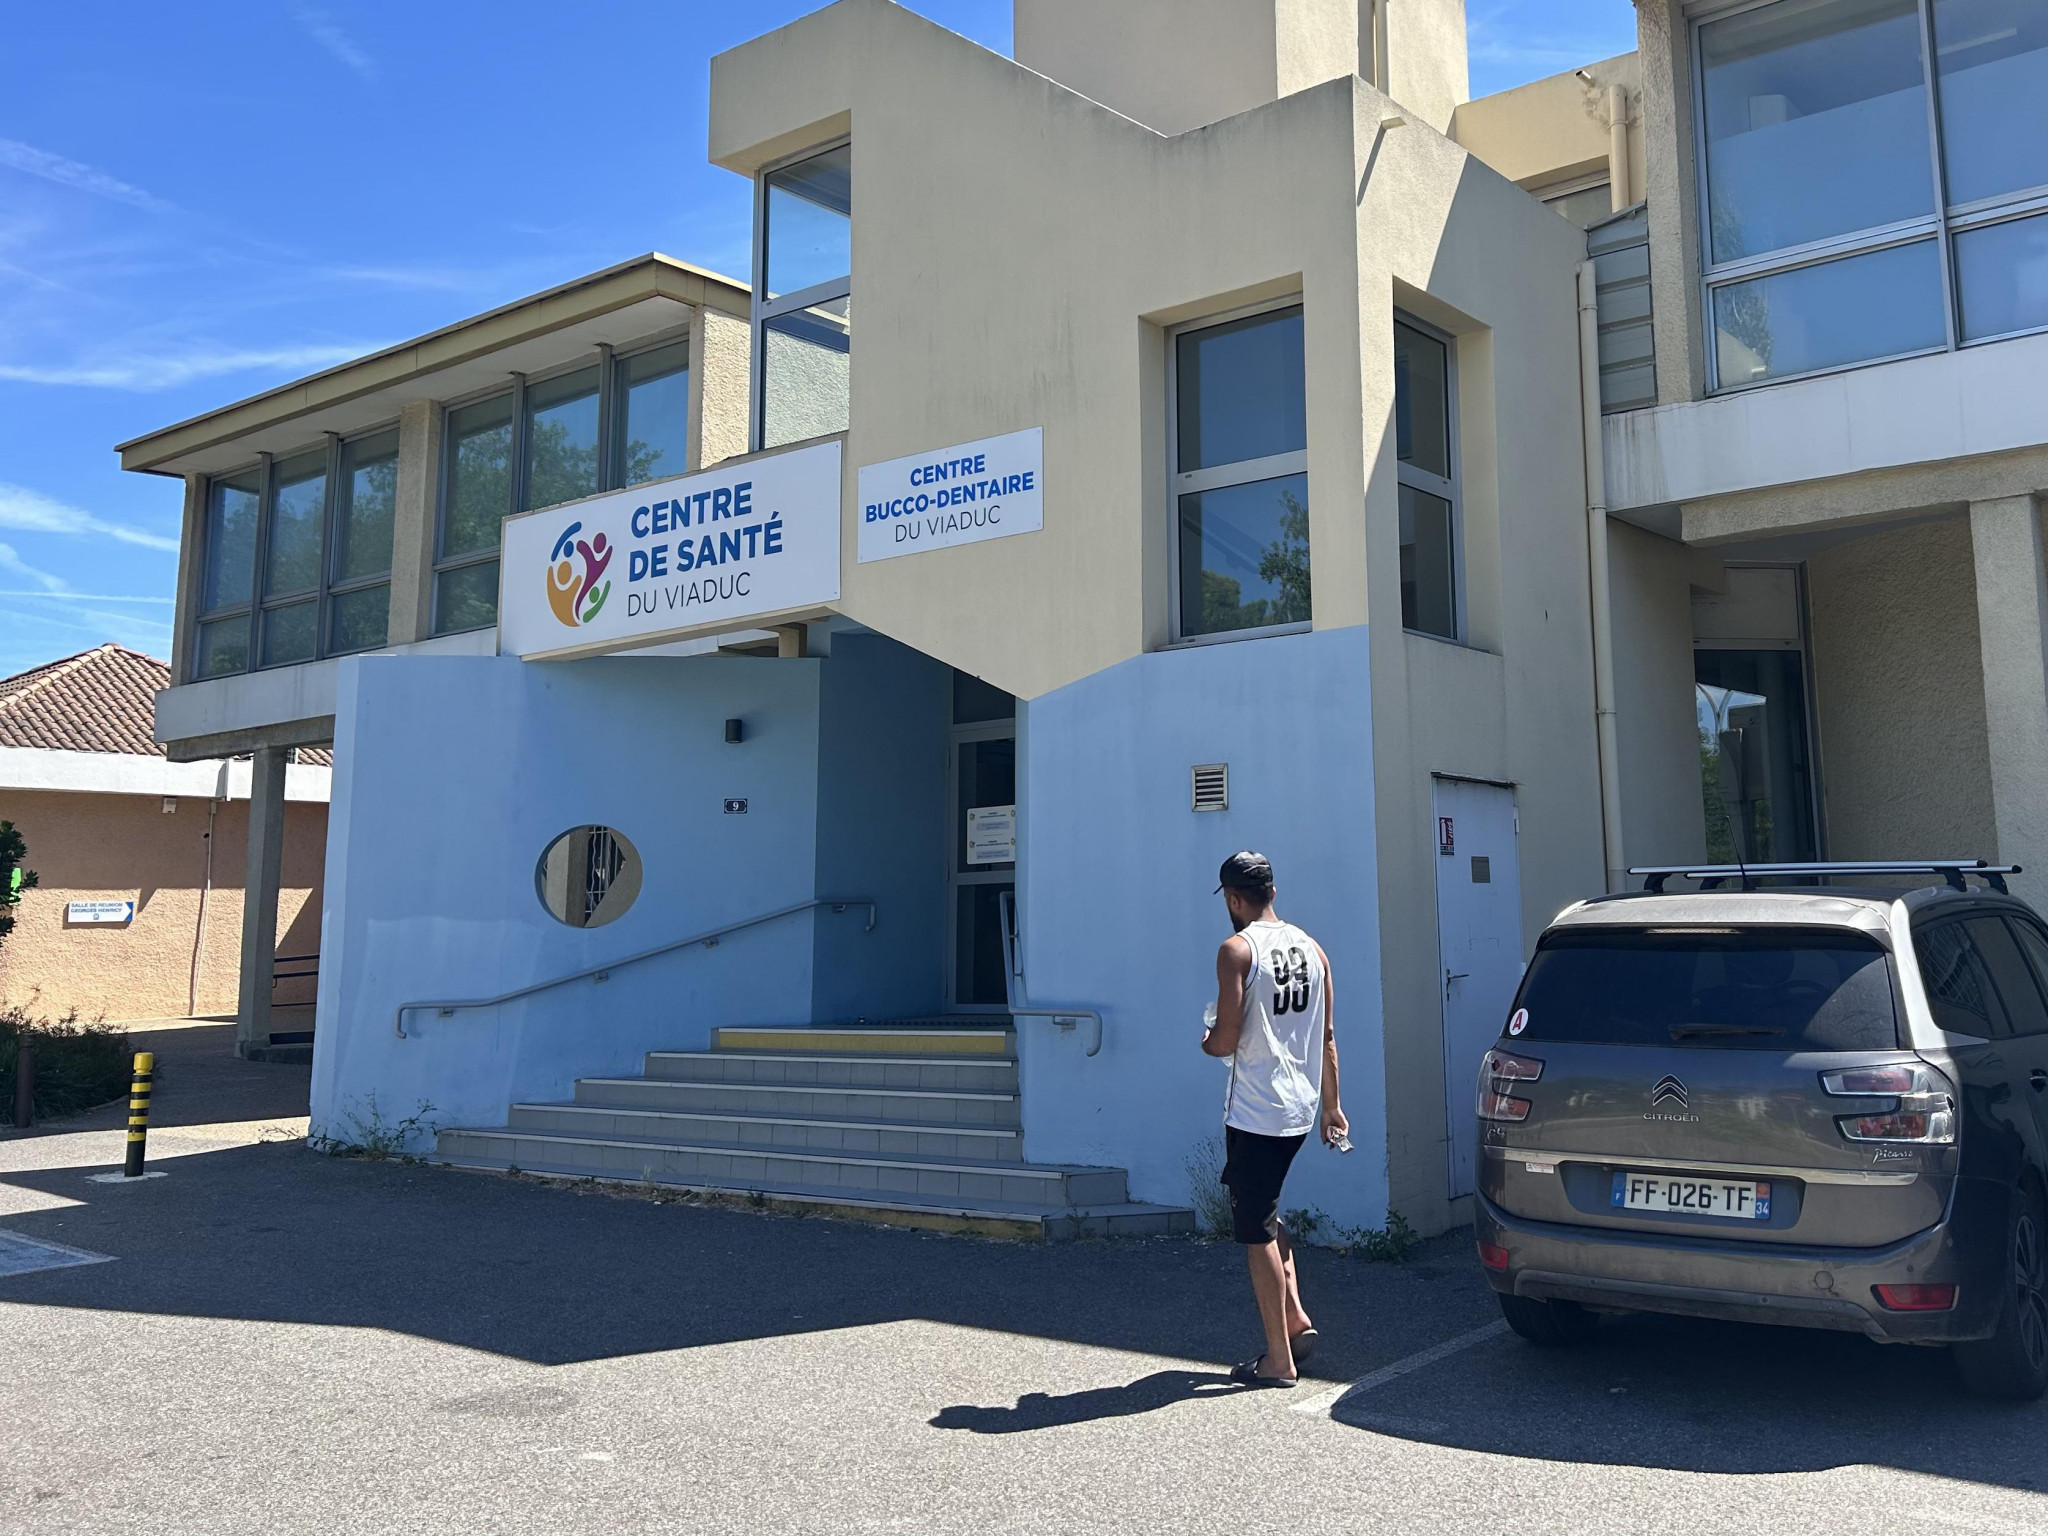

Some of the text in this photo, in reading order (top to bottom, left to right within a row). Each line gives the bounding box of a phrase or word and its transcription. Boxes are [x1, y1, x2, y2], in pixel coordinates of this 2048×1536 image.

[909, 454, 985, 487] CENTRE
[631, 481, 752, 539] CENTRE
[865, 471, 1034, 523] BUCCO-DENTAIRE
[895, 505, 1001, 543] DU VIADUC
[629, 511, 783, 582] DE SANTÉ
[627, 572, 751, 617] DU VIADUC
[732, 801, 740, 811] 9
[1511, 1011, 1523, 1031] A
[1872, 1148, 1913, 1164] Picasso
[1630, 1179, 1752, 1212] FF-026-TF
[1756, 1202, 1769, 1215] 34
